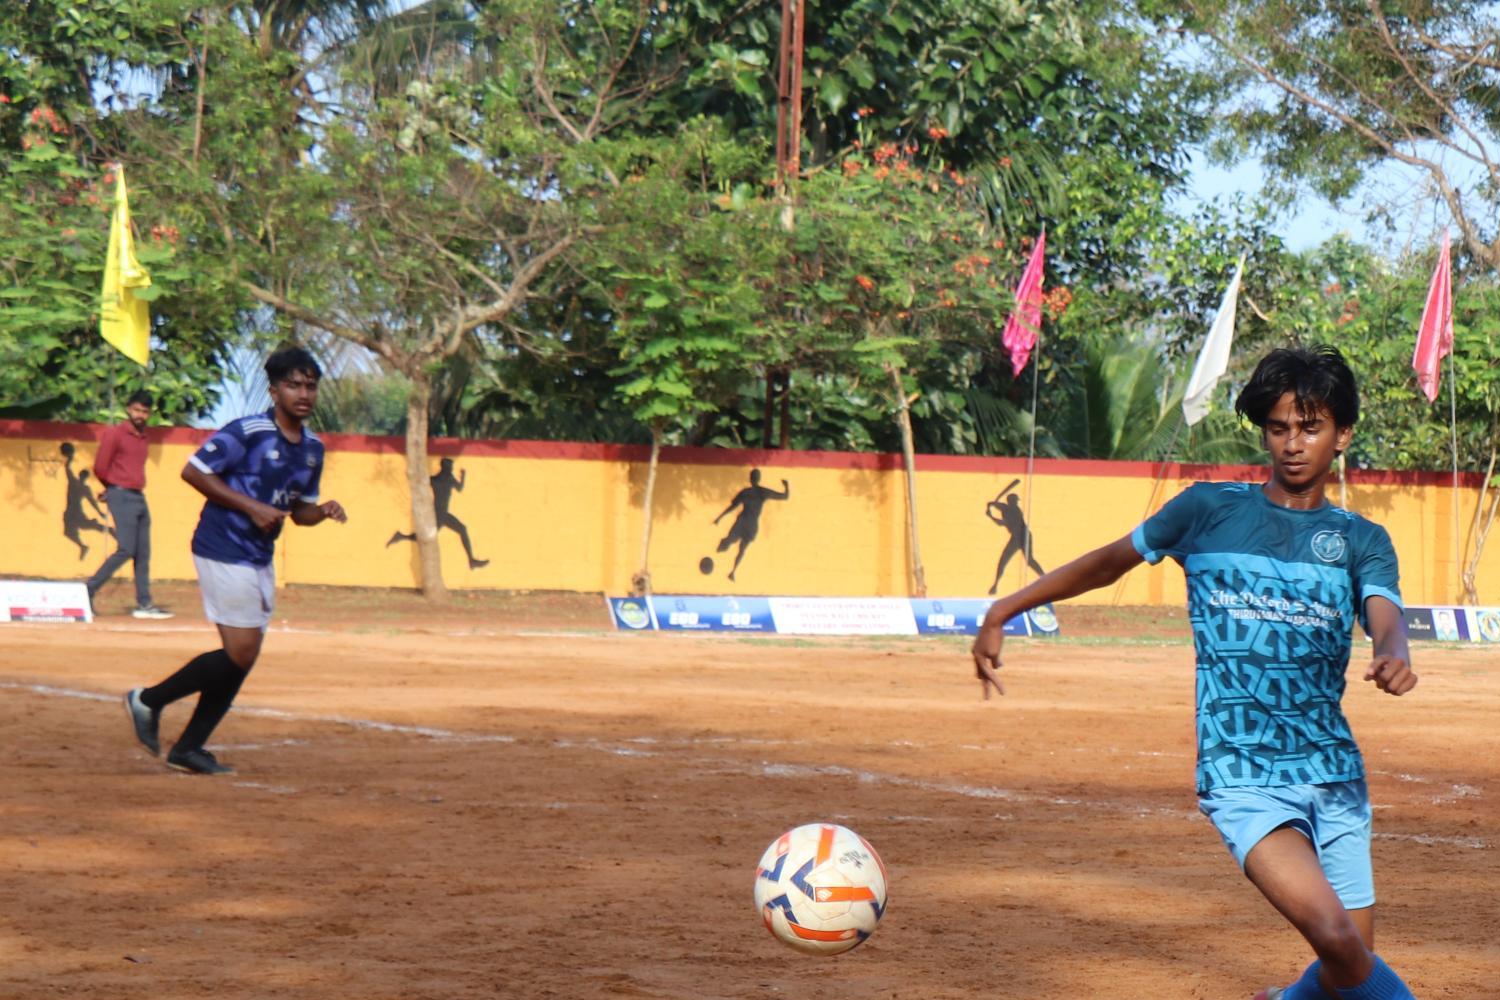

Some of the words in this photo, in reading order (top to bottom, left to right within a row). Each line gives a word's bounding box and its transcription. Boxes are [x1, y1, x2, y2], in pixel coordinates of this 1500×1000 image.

[1209, 589, 1237, 606] The
[1239, 590, 1291, 612] Oxford
[1226, 607, 1329, 629] THIRUVANANHAPURAM
